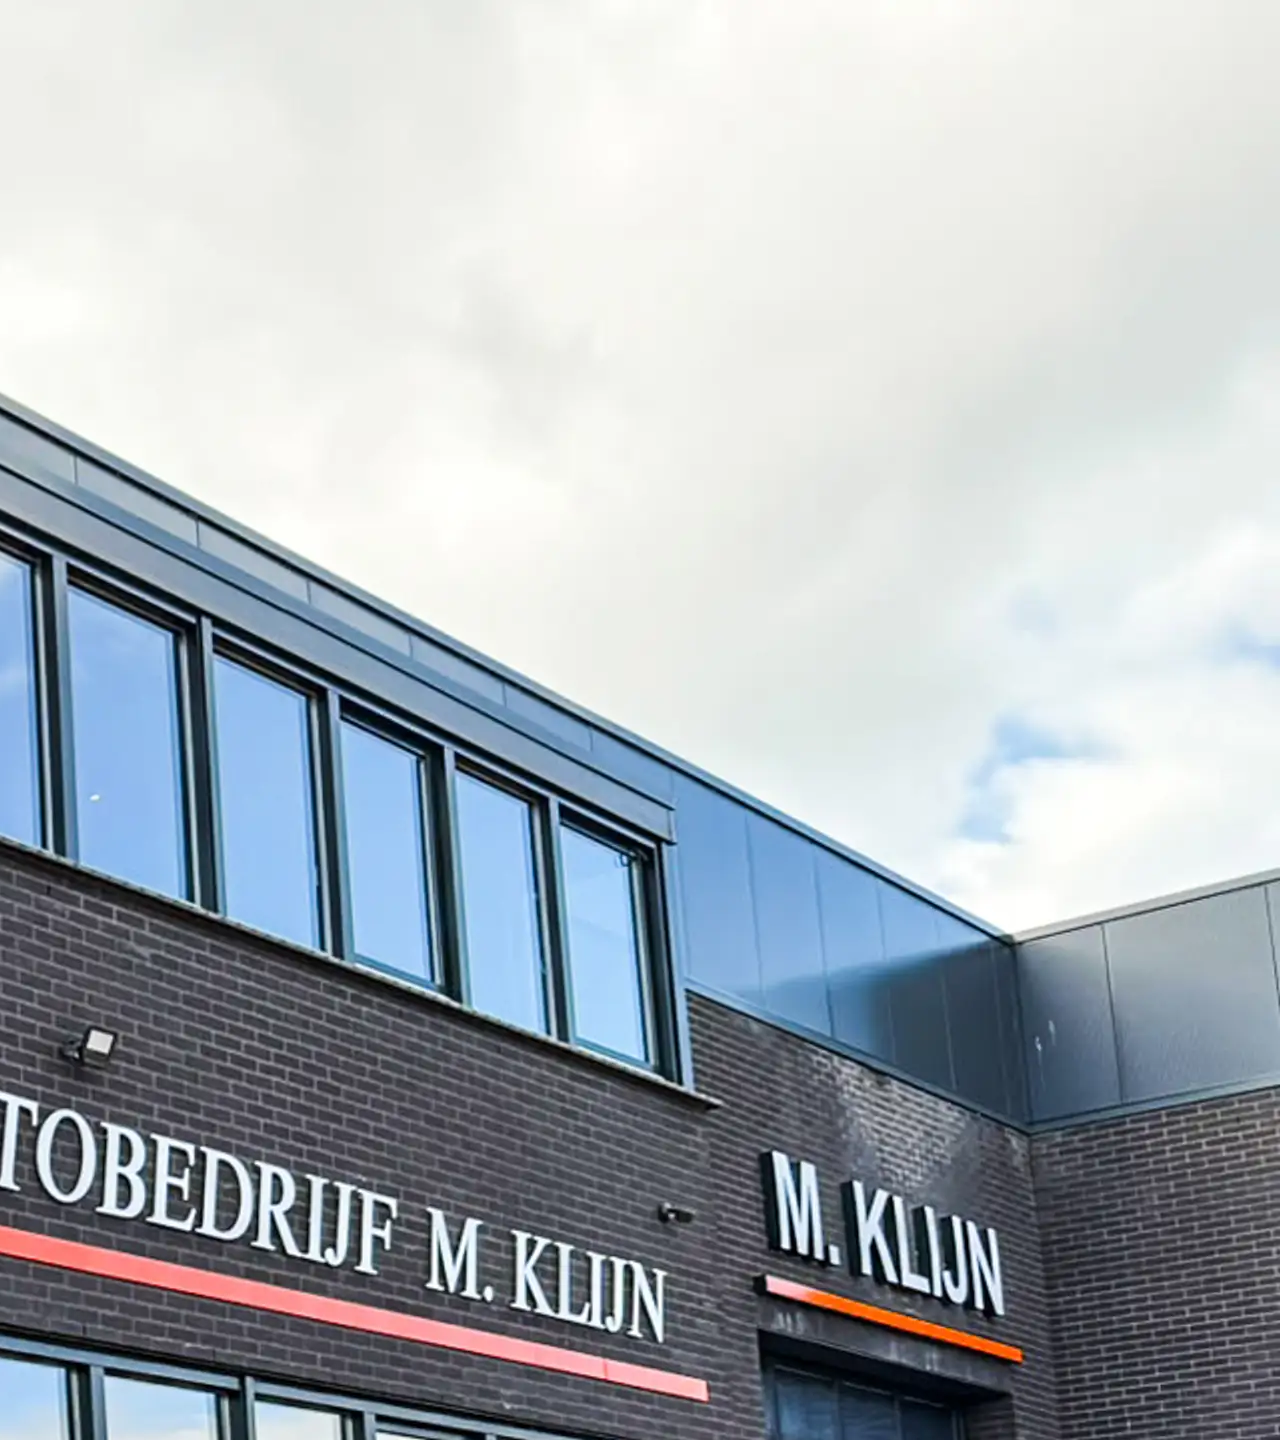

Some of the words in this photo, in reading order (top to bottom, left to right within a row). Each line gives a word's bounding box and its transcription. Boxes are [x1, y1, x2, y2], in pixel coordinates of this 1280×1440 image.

[425, 1206, 493, 1302] M.
[509, 1228, 668, 1344] KLIJN
[770, 1150, 840, 1266] M.
[846, 1178, 1005, 1317] KLIJN
